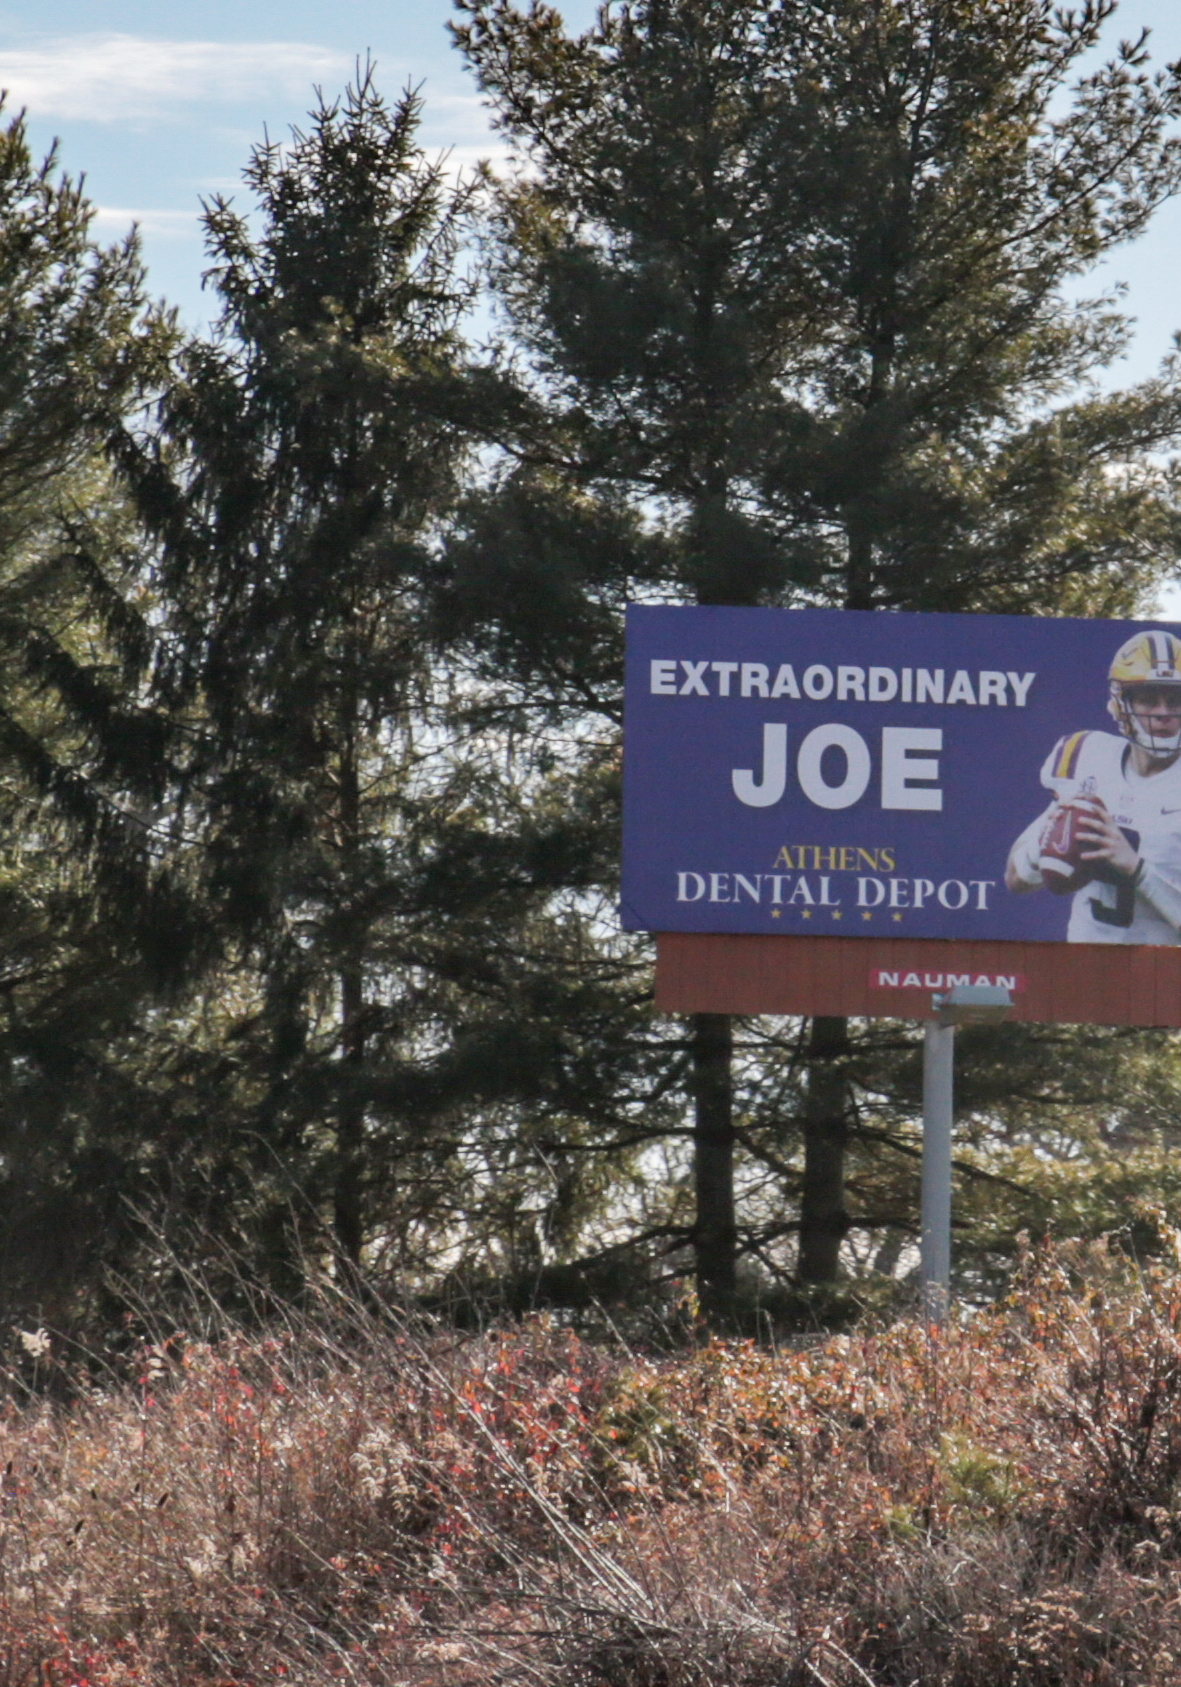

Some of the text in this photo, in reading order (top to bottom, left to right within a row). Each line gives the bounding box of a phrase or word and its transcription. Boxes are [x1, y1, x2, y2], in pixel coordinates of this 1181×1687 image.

[650, 659, 1036, 707] EXTRAORDINARY
[731, 722, 943, 811] JOE
[772, 845, 896, 872] ATHENS
[675, 871, 996, 911] DENTAL DEPOT
[877, 971, 1016, 990] NAUMAN
